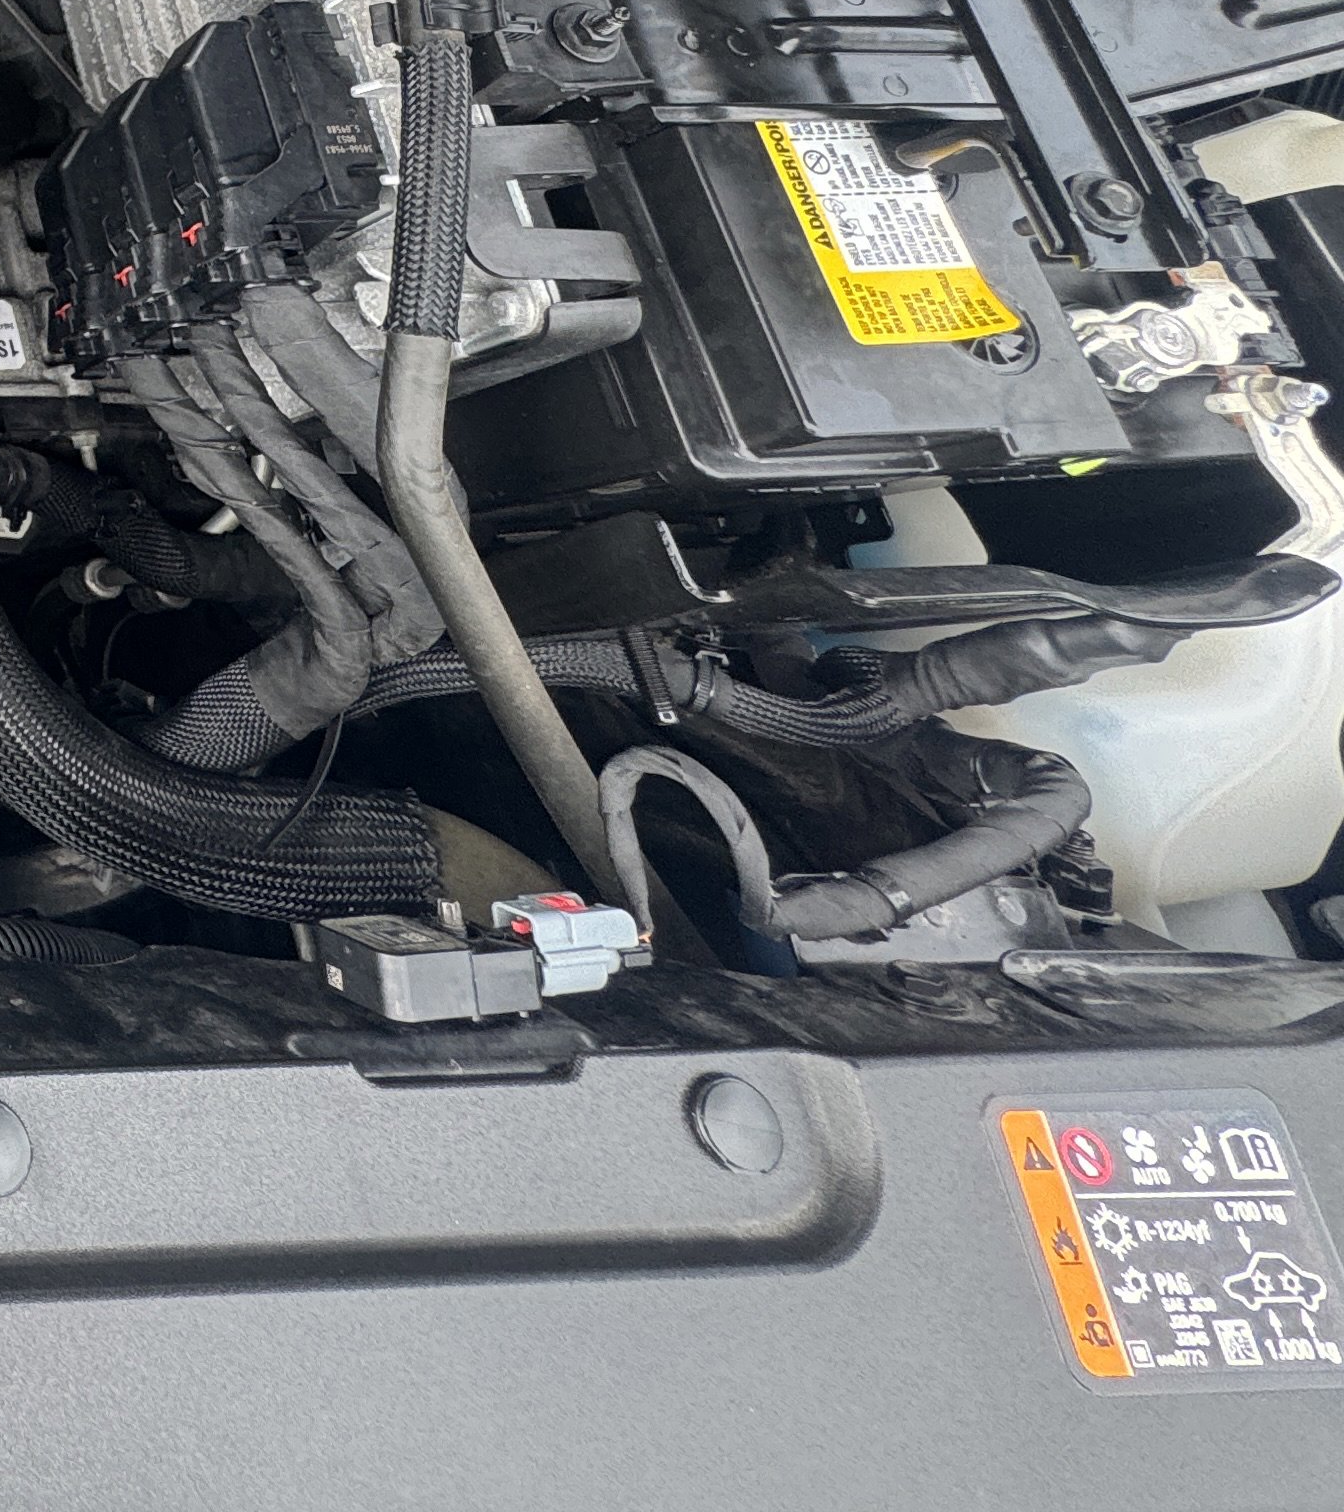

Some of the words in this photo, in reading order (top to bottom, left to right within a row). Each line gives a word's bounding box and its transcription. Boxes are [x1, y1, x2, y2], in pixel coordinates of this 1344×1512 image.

[1132, 1166, 1172, 1186] AUTO
[1213, 1200, 1262, 1223] 0.700
[1260, 1200, 1288, 1226] kg
[1134, 1218, 1212, 1245] R-1234yf
[1152, 1272, 1194, 1296] PAG
[1264, 1337, 1316, 1361] 1.000
[1312, 1336, 1343, 1365] kg
